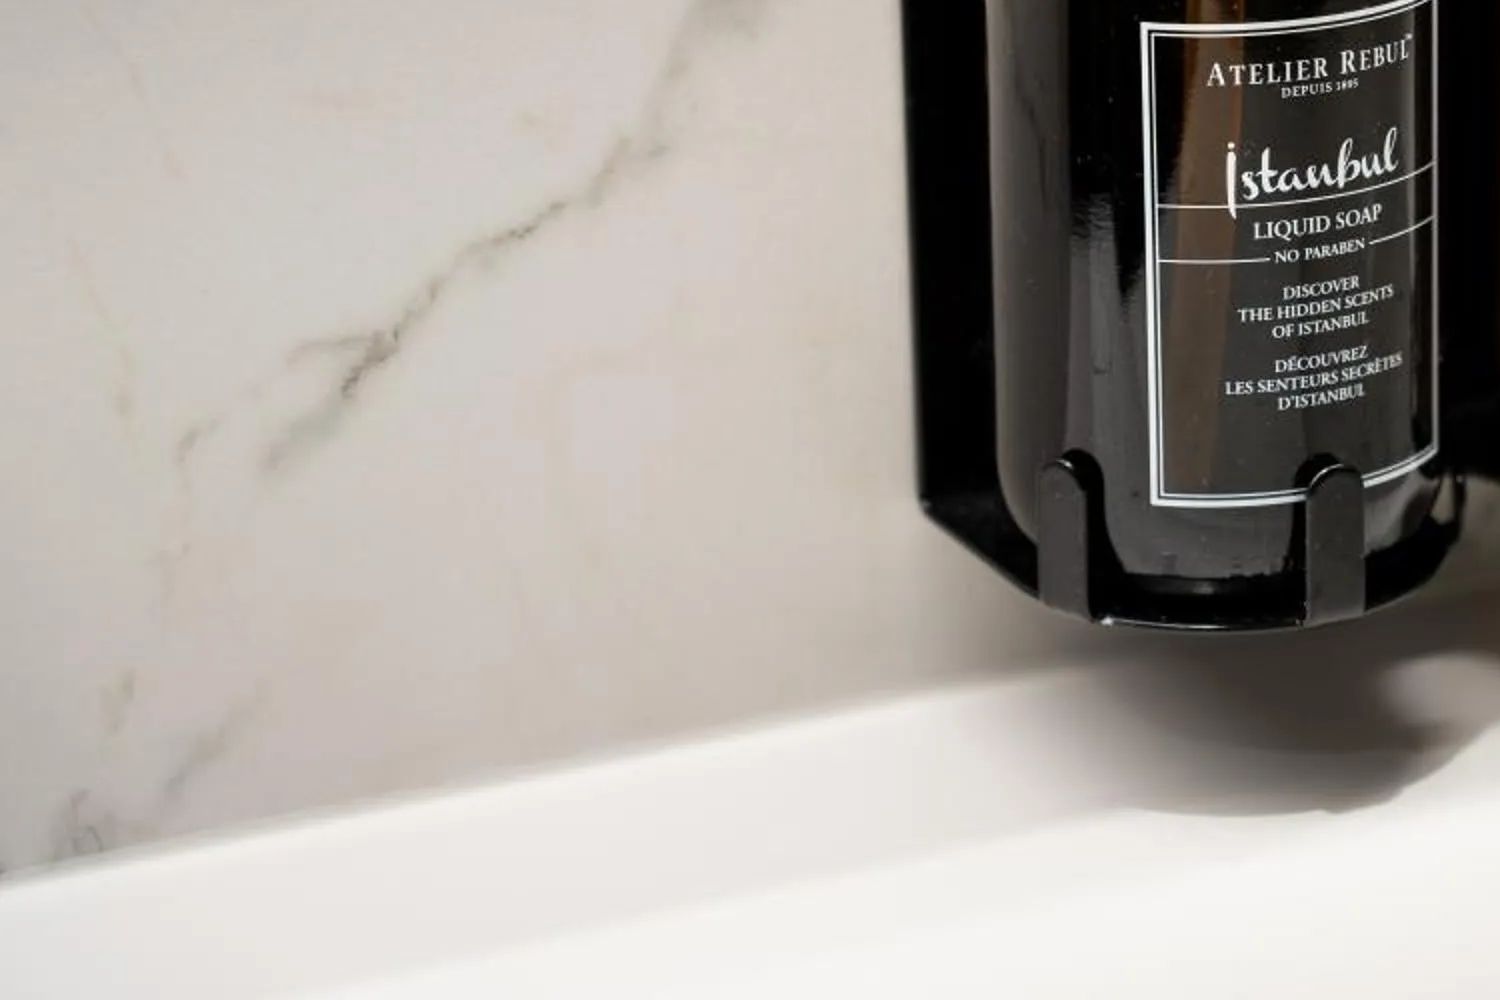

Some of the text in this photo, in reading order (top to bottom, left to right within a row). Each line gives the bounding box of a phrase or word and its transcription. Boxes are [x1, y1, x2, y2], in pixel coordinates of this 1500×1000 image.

[1206, 39, 1408, 87] ATELIER REBUL
[1281, 82, 1333, 98] DEPUIS
[1254, 203, 1383, 241] LIQUID SOAP
[1275, 237, 1366, 264] NO PARABEN
[1283, 275, 1360, 300] DISCOVER
[1237, 284, 1395, 324] THE HIDDEN SCENTS
[1271, 311, 1370, 339] OF ISTANBUL
[1275, 346, 1369, 374] DÉCOUVREZ
[1225, 380, 1254, 396] LES
[1257, 370, 1339, 394] SENTEURS
[1278, 383, 1366, 411] D'ISTANBUL
